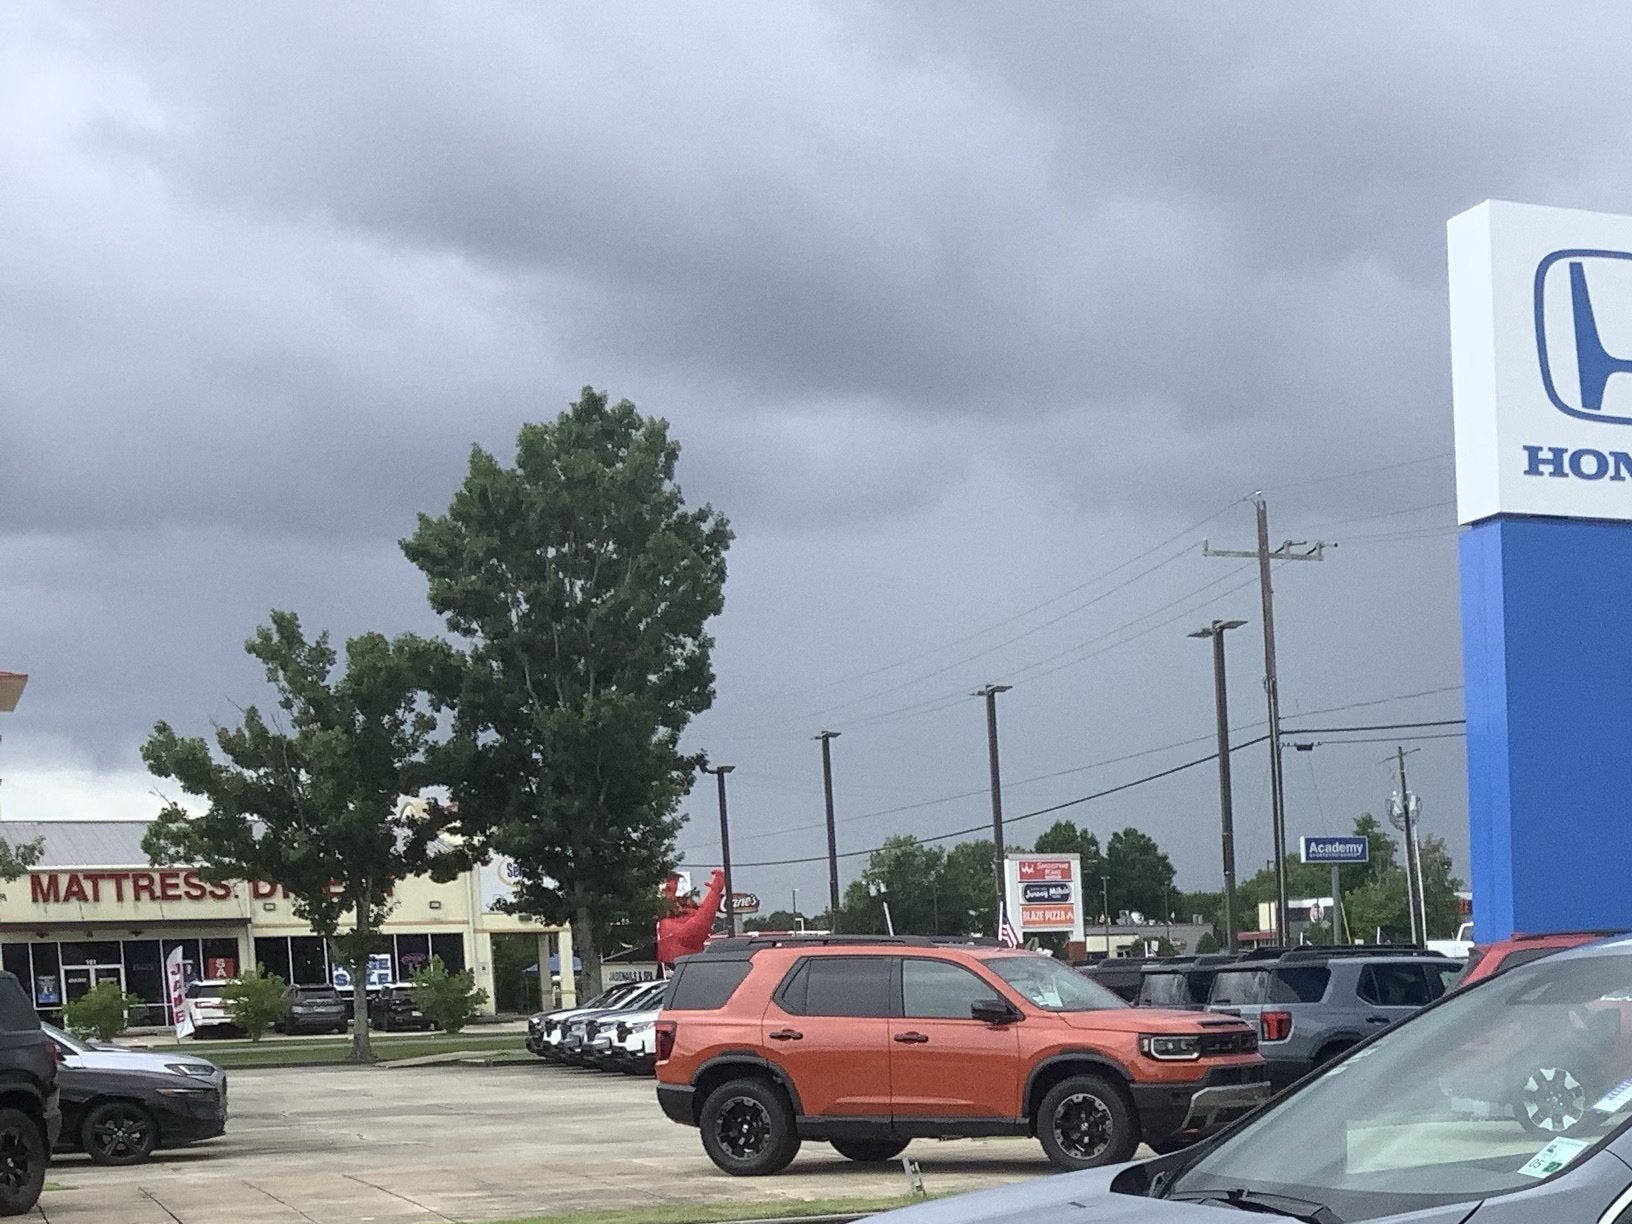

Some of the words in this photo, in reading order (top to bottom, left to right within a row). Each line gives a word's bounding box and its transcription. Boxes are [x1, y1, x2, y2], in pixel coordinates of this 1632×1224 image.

[1309, 841, 1363, 856] Academy
[31, 872, 231, 903] MATTRESS
[1023, 910, 1044, 922] BLAZE
[1045, 910, 1066, 921] PIZZA
